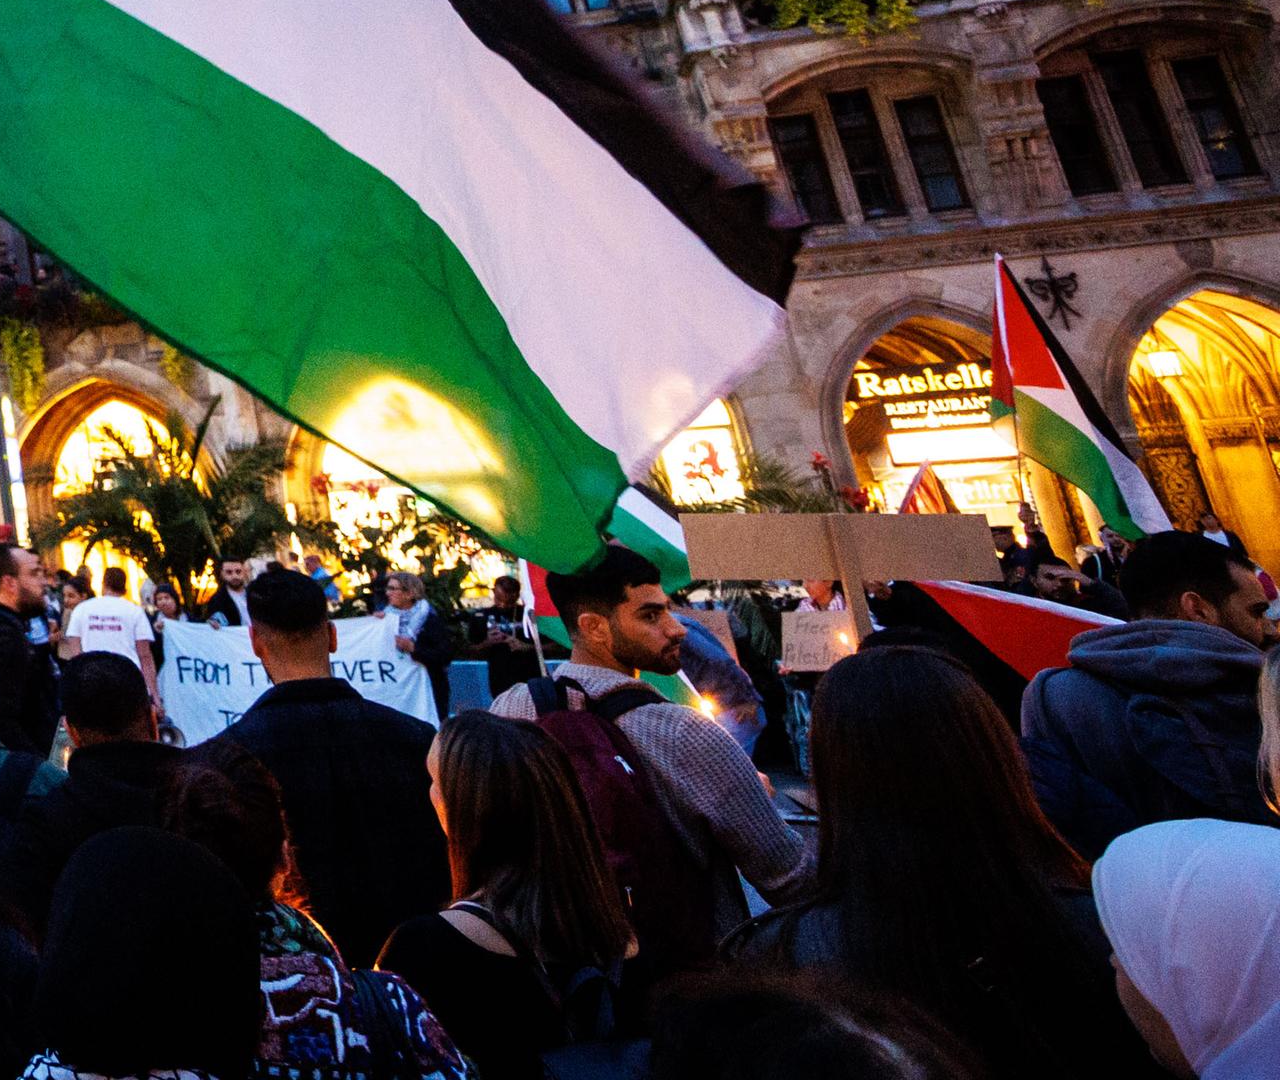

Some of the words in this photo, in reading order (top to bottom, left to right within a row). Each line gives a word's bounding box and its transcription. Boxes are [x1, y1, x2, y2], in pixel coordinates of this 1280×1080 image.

[853, 362, 993, 398] Ratskelle
[175, 655, 231, 686] FROM
[330, 659, 398, 683] IVER
